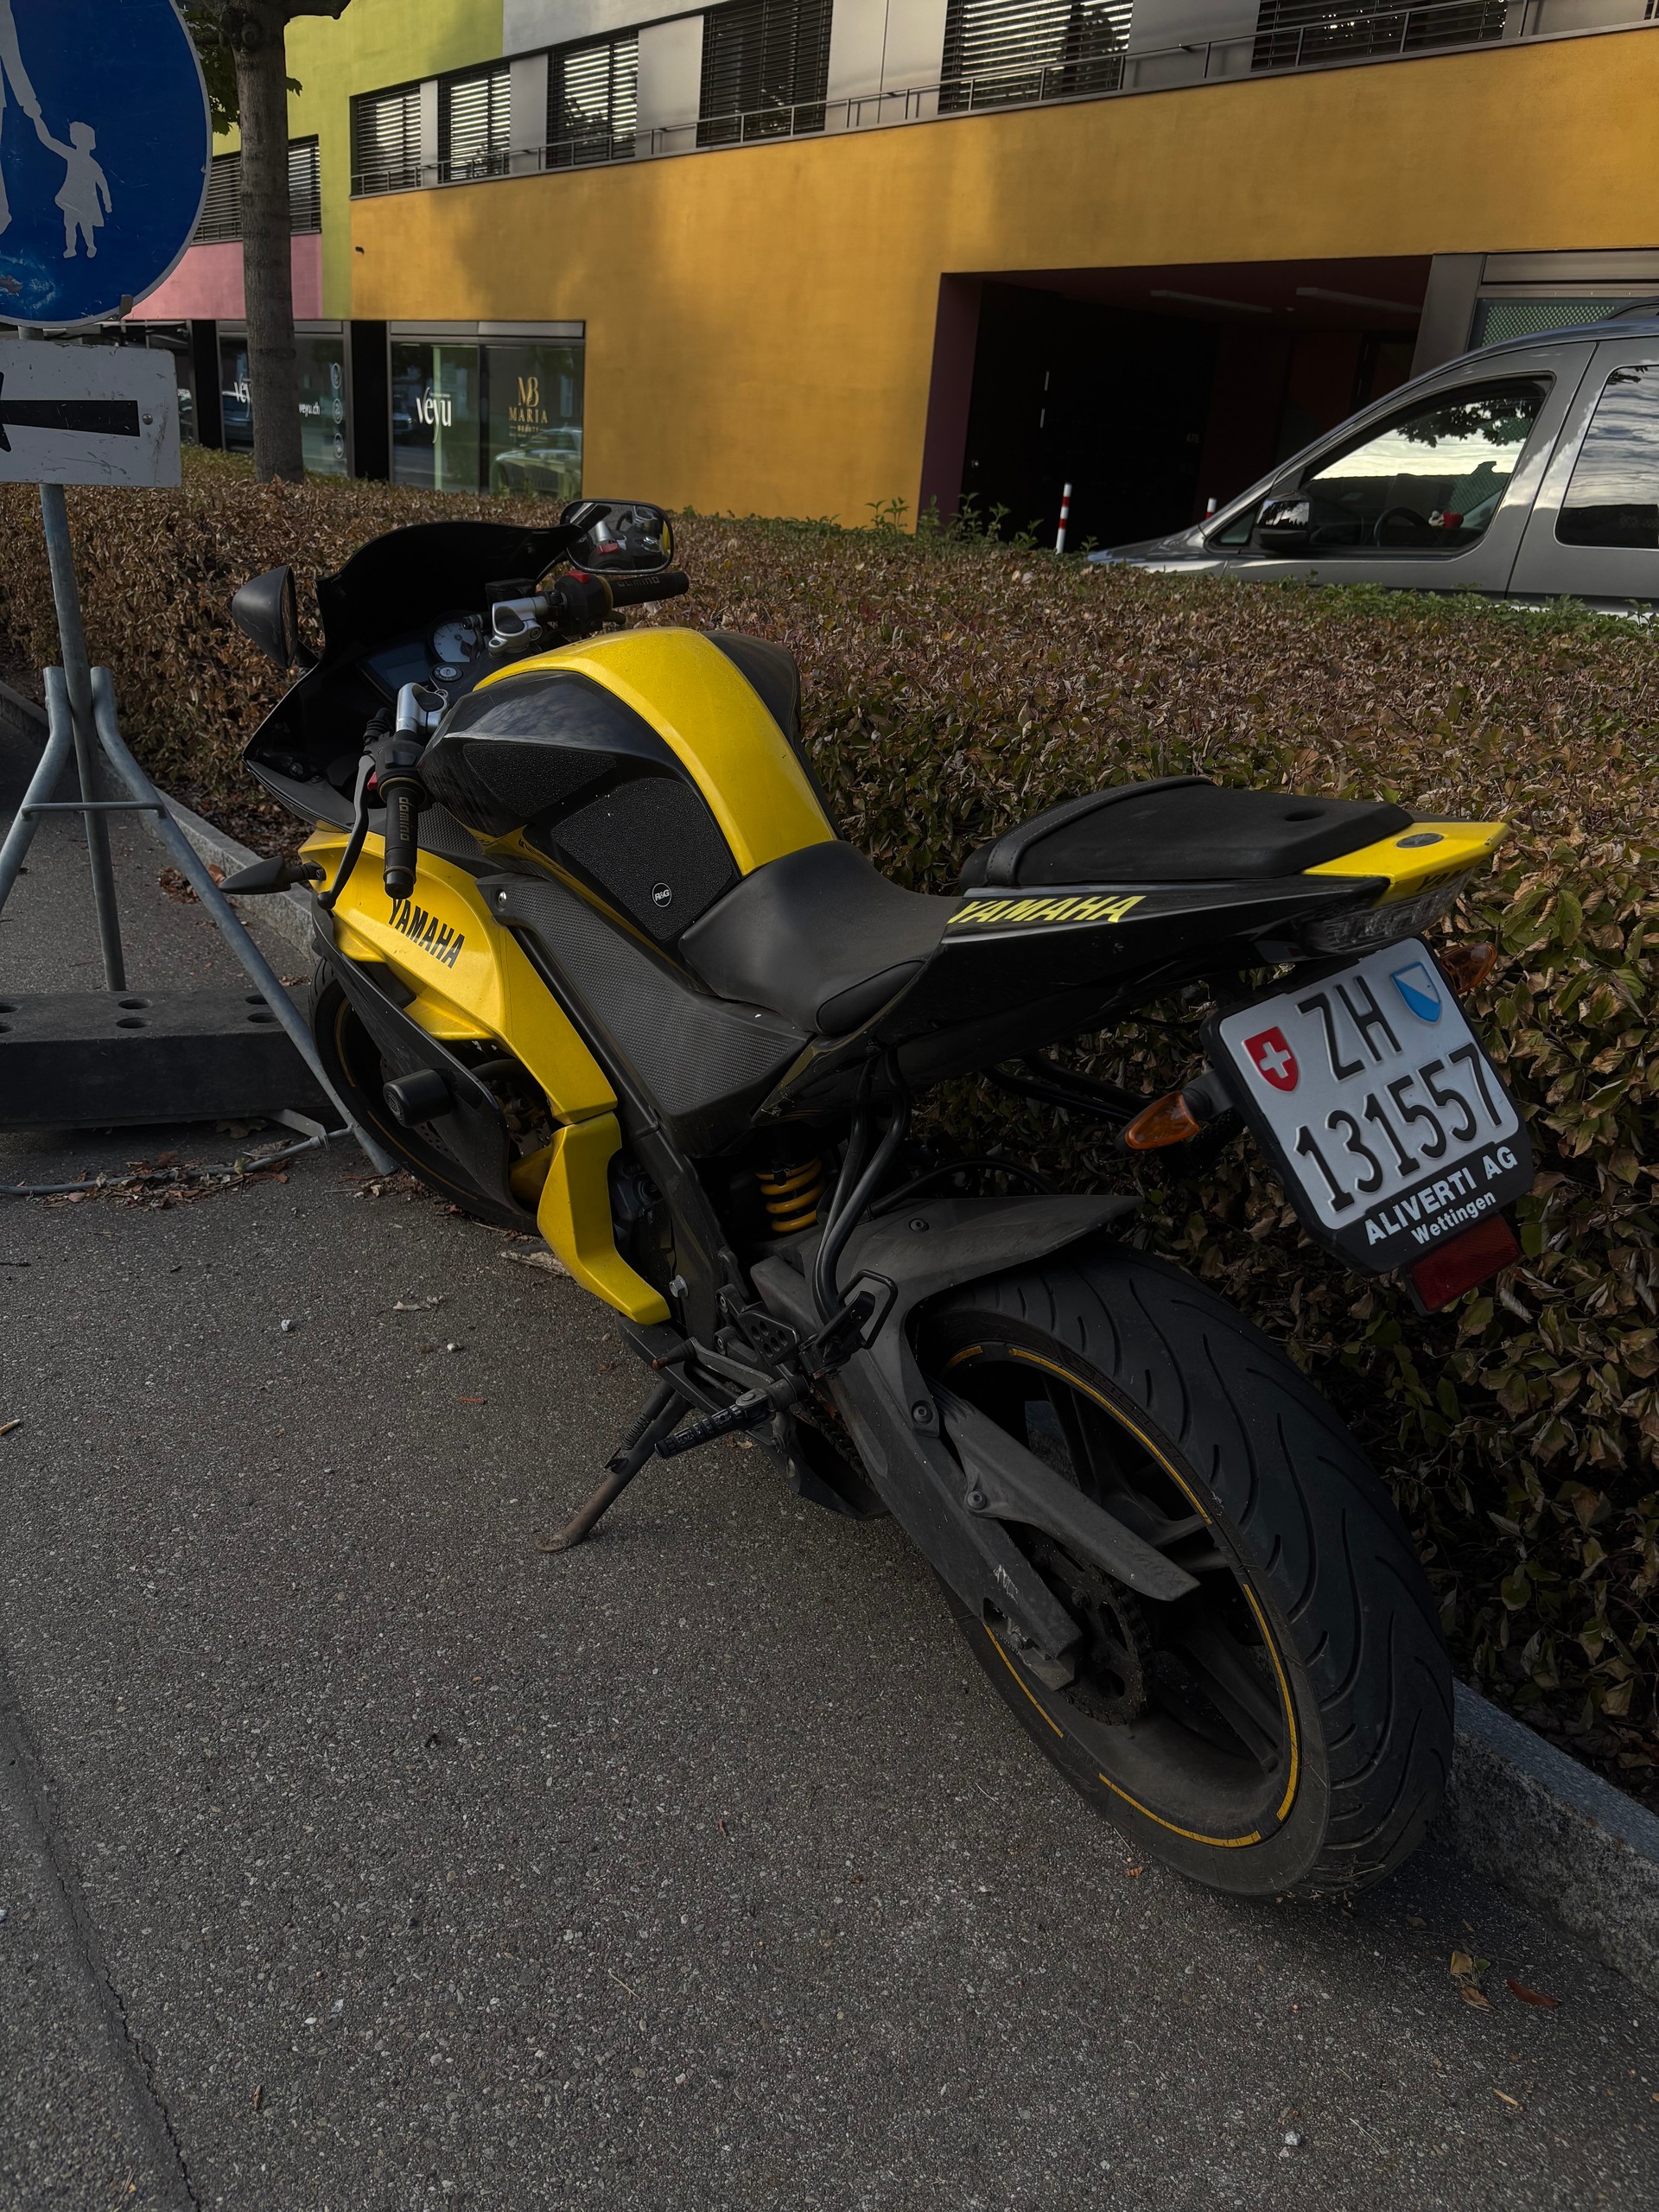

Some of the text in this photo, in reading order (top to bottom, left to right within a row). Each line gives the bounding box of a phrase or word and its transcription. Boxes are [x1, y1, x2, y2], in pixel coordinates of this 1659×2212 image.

[508, 407, 549, 423] MARIA
[398, 797, 410, 842] domino
[654, 889, 671, 901] R&G
[947, 895, 1147, 924] YAMAHA
[388, 898, 465, 969] YAMAHA
[1297, 975, 1402, 1081] ZH
[1295, 1042, 1503, 1212] 131557
[1364, 1146, 1518, 1245] ALIVERTI AG
[1410, 1192, 1497, 1244] Wettingen
